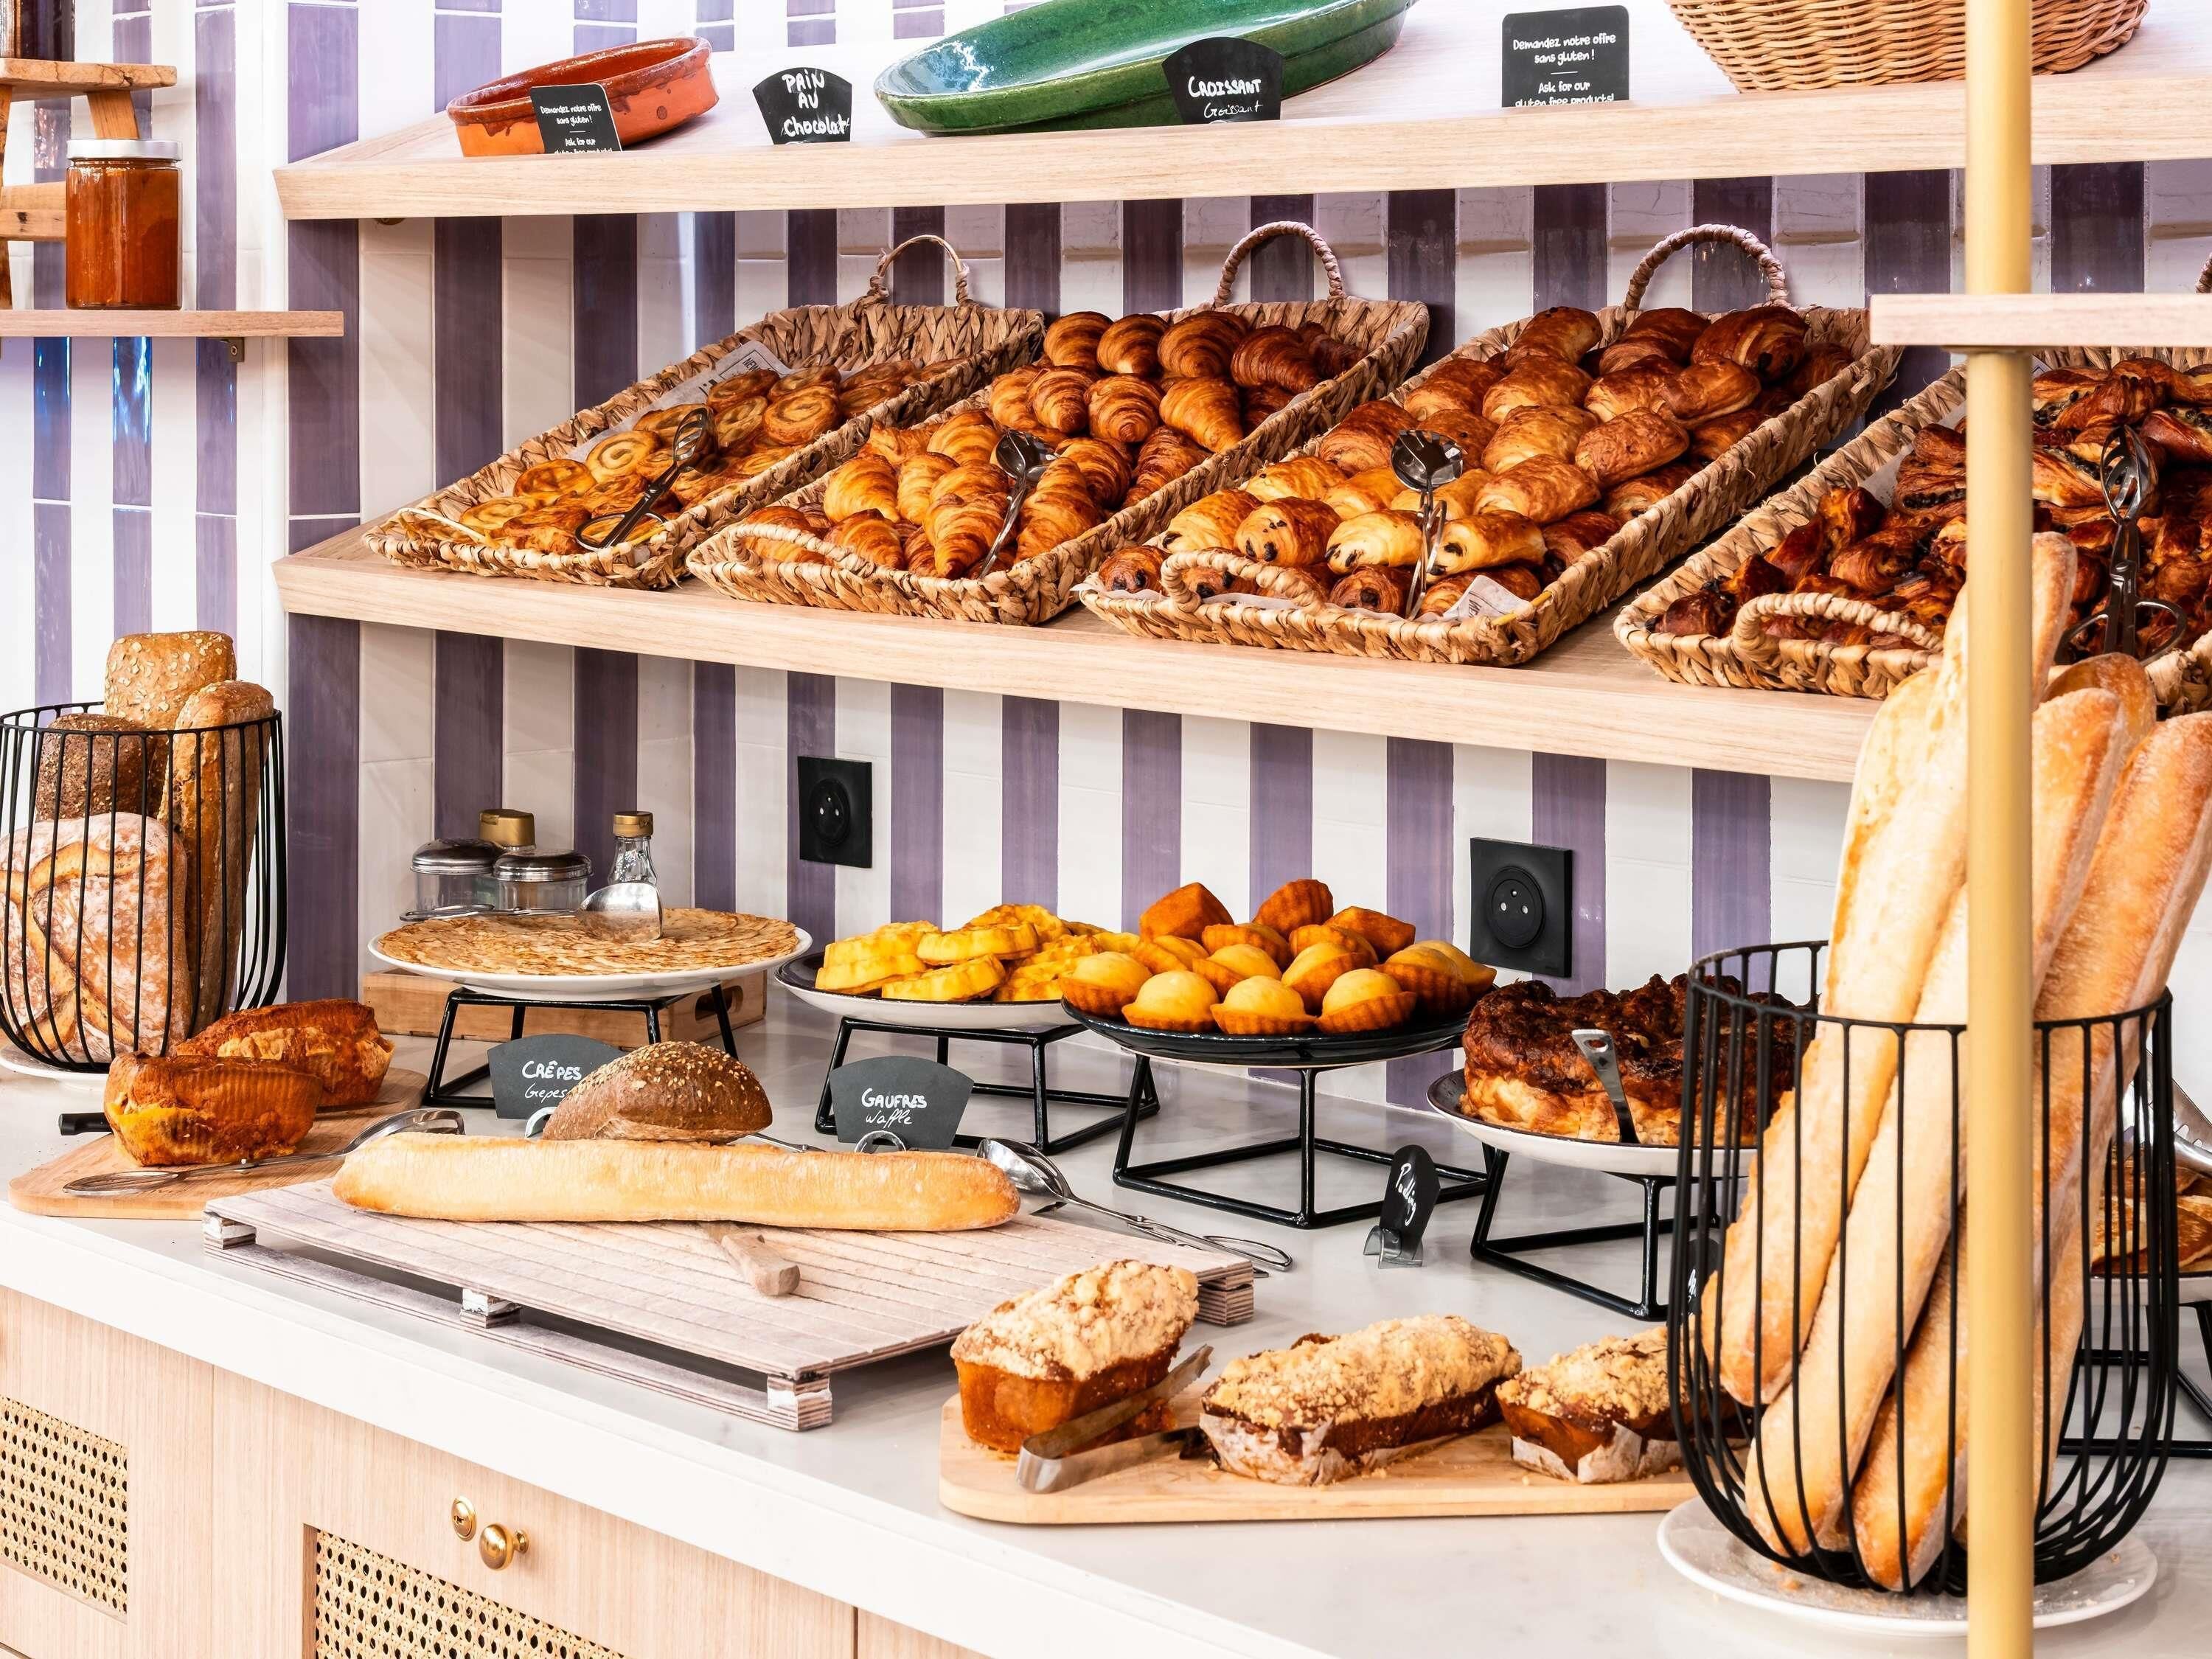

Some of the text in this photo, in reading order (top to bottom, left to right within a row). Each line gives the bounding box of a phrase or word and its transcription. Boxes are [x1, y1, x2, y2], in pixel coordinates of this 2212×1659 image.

[1513, 32, 1616, 50] Demandez notre offre
[1534, 54, 1556, 64] sans
[1557, 52, 1590, 66] gluten
[1188, 76, 1262, 97] CROISSANT
[1538, 81, 1590, 94] Ask for our
[540, 103, 602, 114] Demandez notre offre
[798, 91, 818, 109] AU
[570, 115, 589, 126] gluten
[783, 114, 849, 137] Chocolat
[565, 138, 575, 146] Ask
[522, 1060, 582, 1081] CRÊPES
[861, 1088, 928, 1109] GAUFRES
